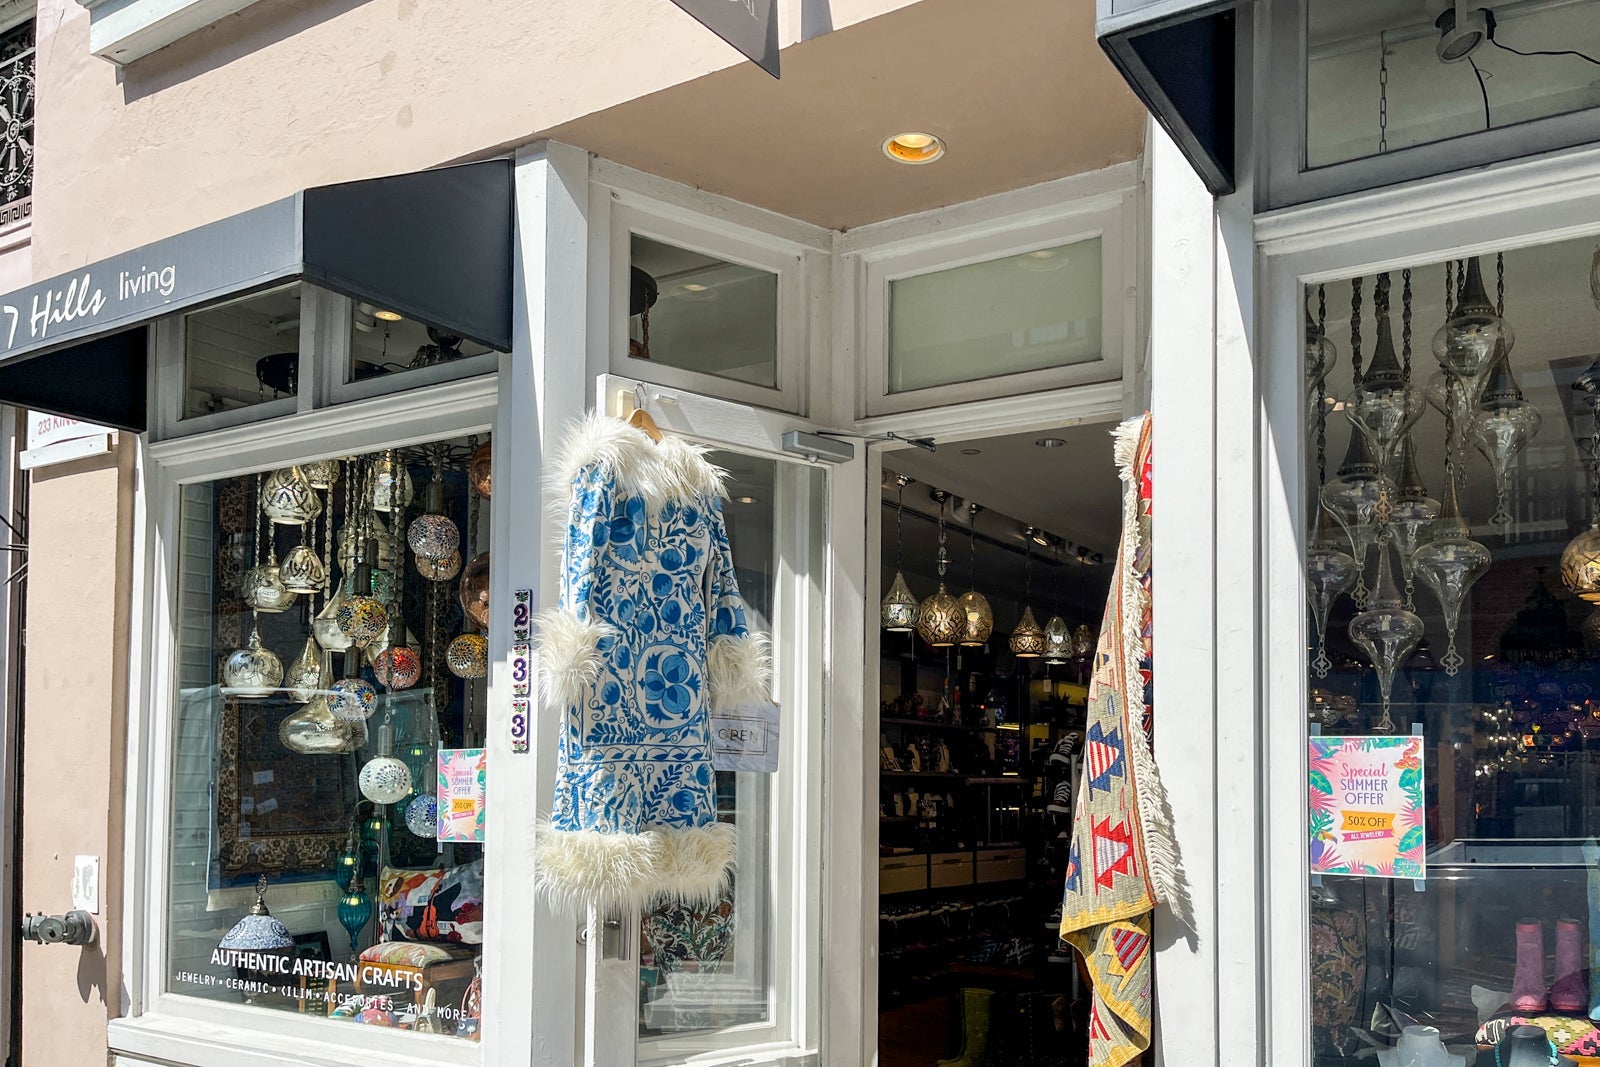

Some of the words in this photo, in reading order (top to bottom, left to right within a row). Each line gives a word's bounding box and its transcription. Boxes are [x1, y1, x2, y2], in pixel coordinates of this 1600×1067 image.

[3, 305, 19, 349] 7
[31, 273, 107, 338] Hills
[119, 265, 176, 301] living
[38, 417, 51, 435] 233
[718, 728, 759, 743] OPEN
[452, 767, 473, 780] Special
[1340, 762, 1389, 783] Special
[451, 777, 473, 786] SUMMER
[1340, 778, 1388, 791] SUMMER
[453, 786, 471, 795] OFFER
[1345, 792, 1384, 805] OFFER
[1348, 815, 1366, 827] 50%
[1367, 816, 1387, 827] OFF
[210, 948, 290, 974] AUTHENTIC
[292, 958, 358, 982] ARTISAN
[362, 966, 424, 991] CRAFTS
[175, 971, 216, 986] JEWELRY
[226, 978, 269, 994] CERAMIC
[406, 1002, 429, 1016] AND
[436, 1006, 468, 1022] MORE
